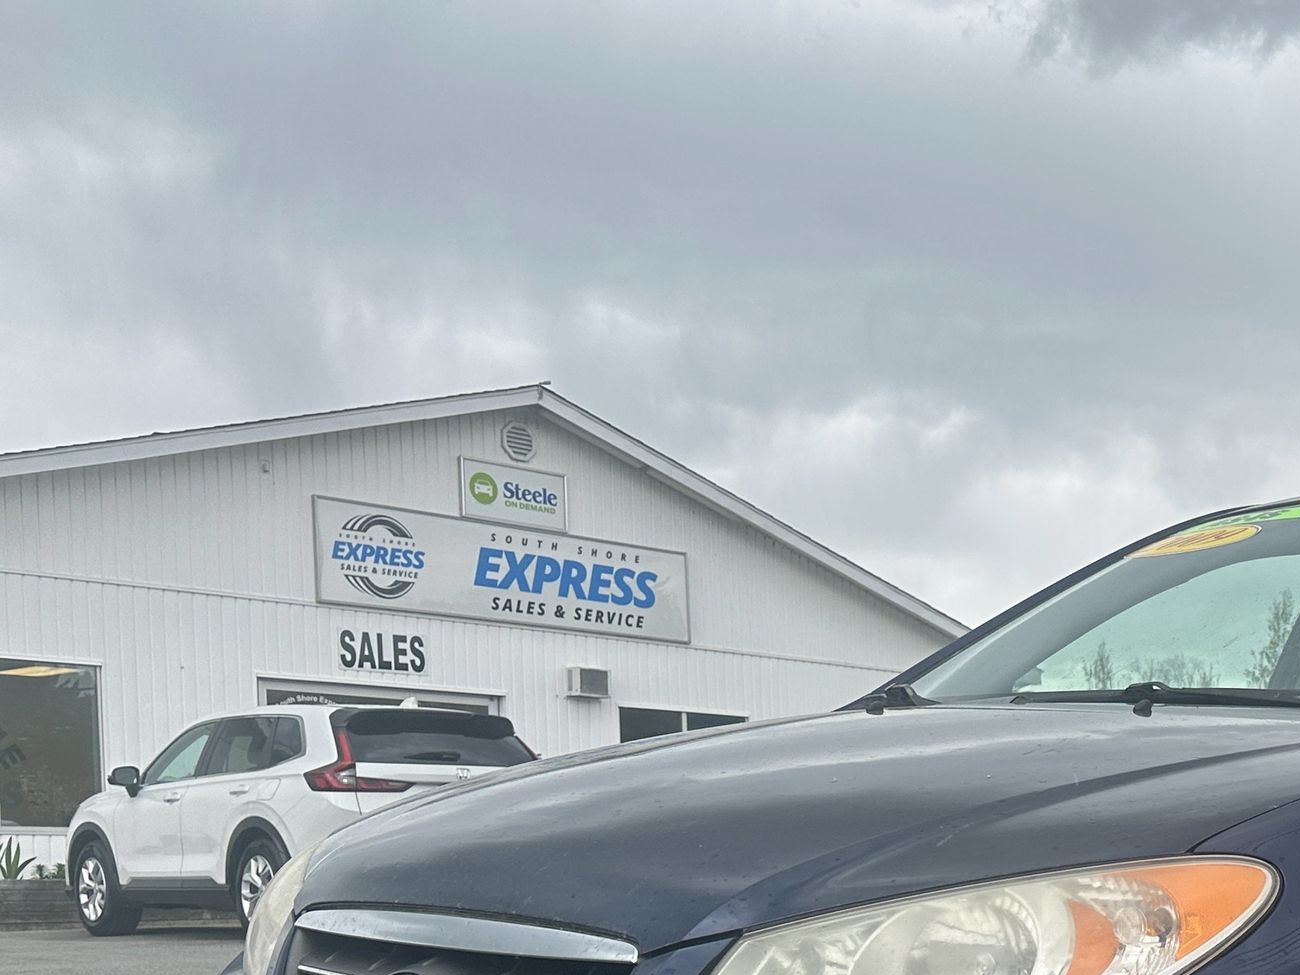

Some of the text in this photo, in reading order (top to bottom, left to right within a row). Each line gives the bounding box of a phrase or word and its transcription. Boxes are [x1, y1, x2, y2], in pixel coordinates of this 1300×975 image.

[503, 481, 558, 507] Steele
[504, 500, 556, 515] ON DEMAND
[331, 540, 426, 570] EXPRESS
[490, 532, 640, 564] SOUTH SHORE
[340, 563, 368, 573] SALES
[381, 567, 419, 579] SERVICE
[473, 546, 659, 609] EXPRESS
[491, 596, 645, 629] SALES & SERVICE
[339, 629, 426, 673] SALES
